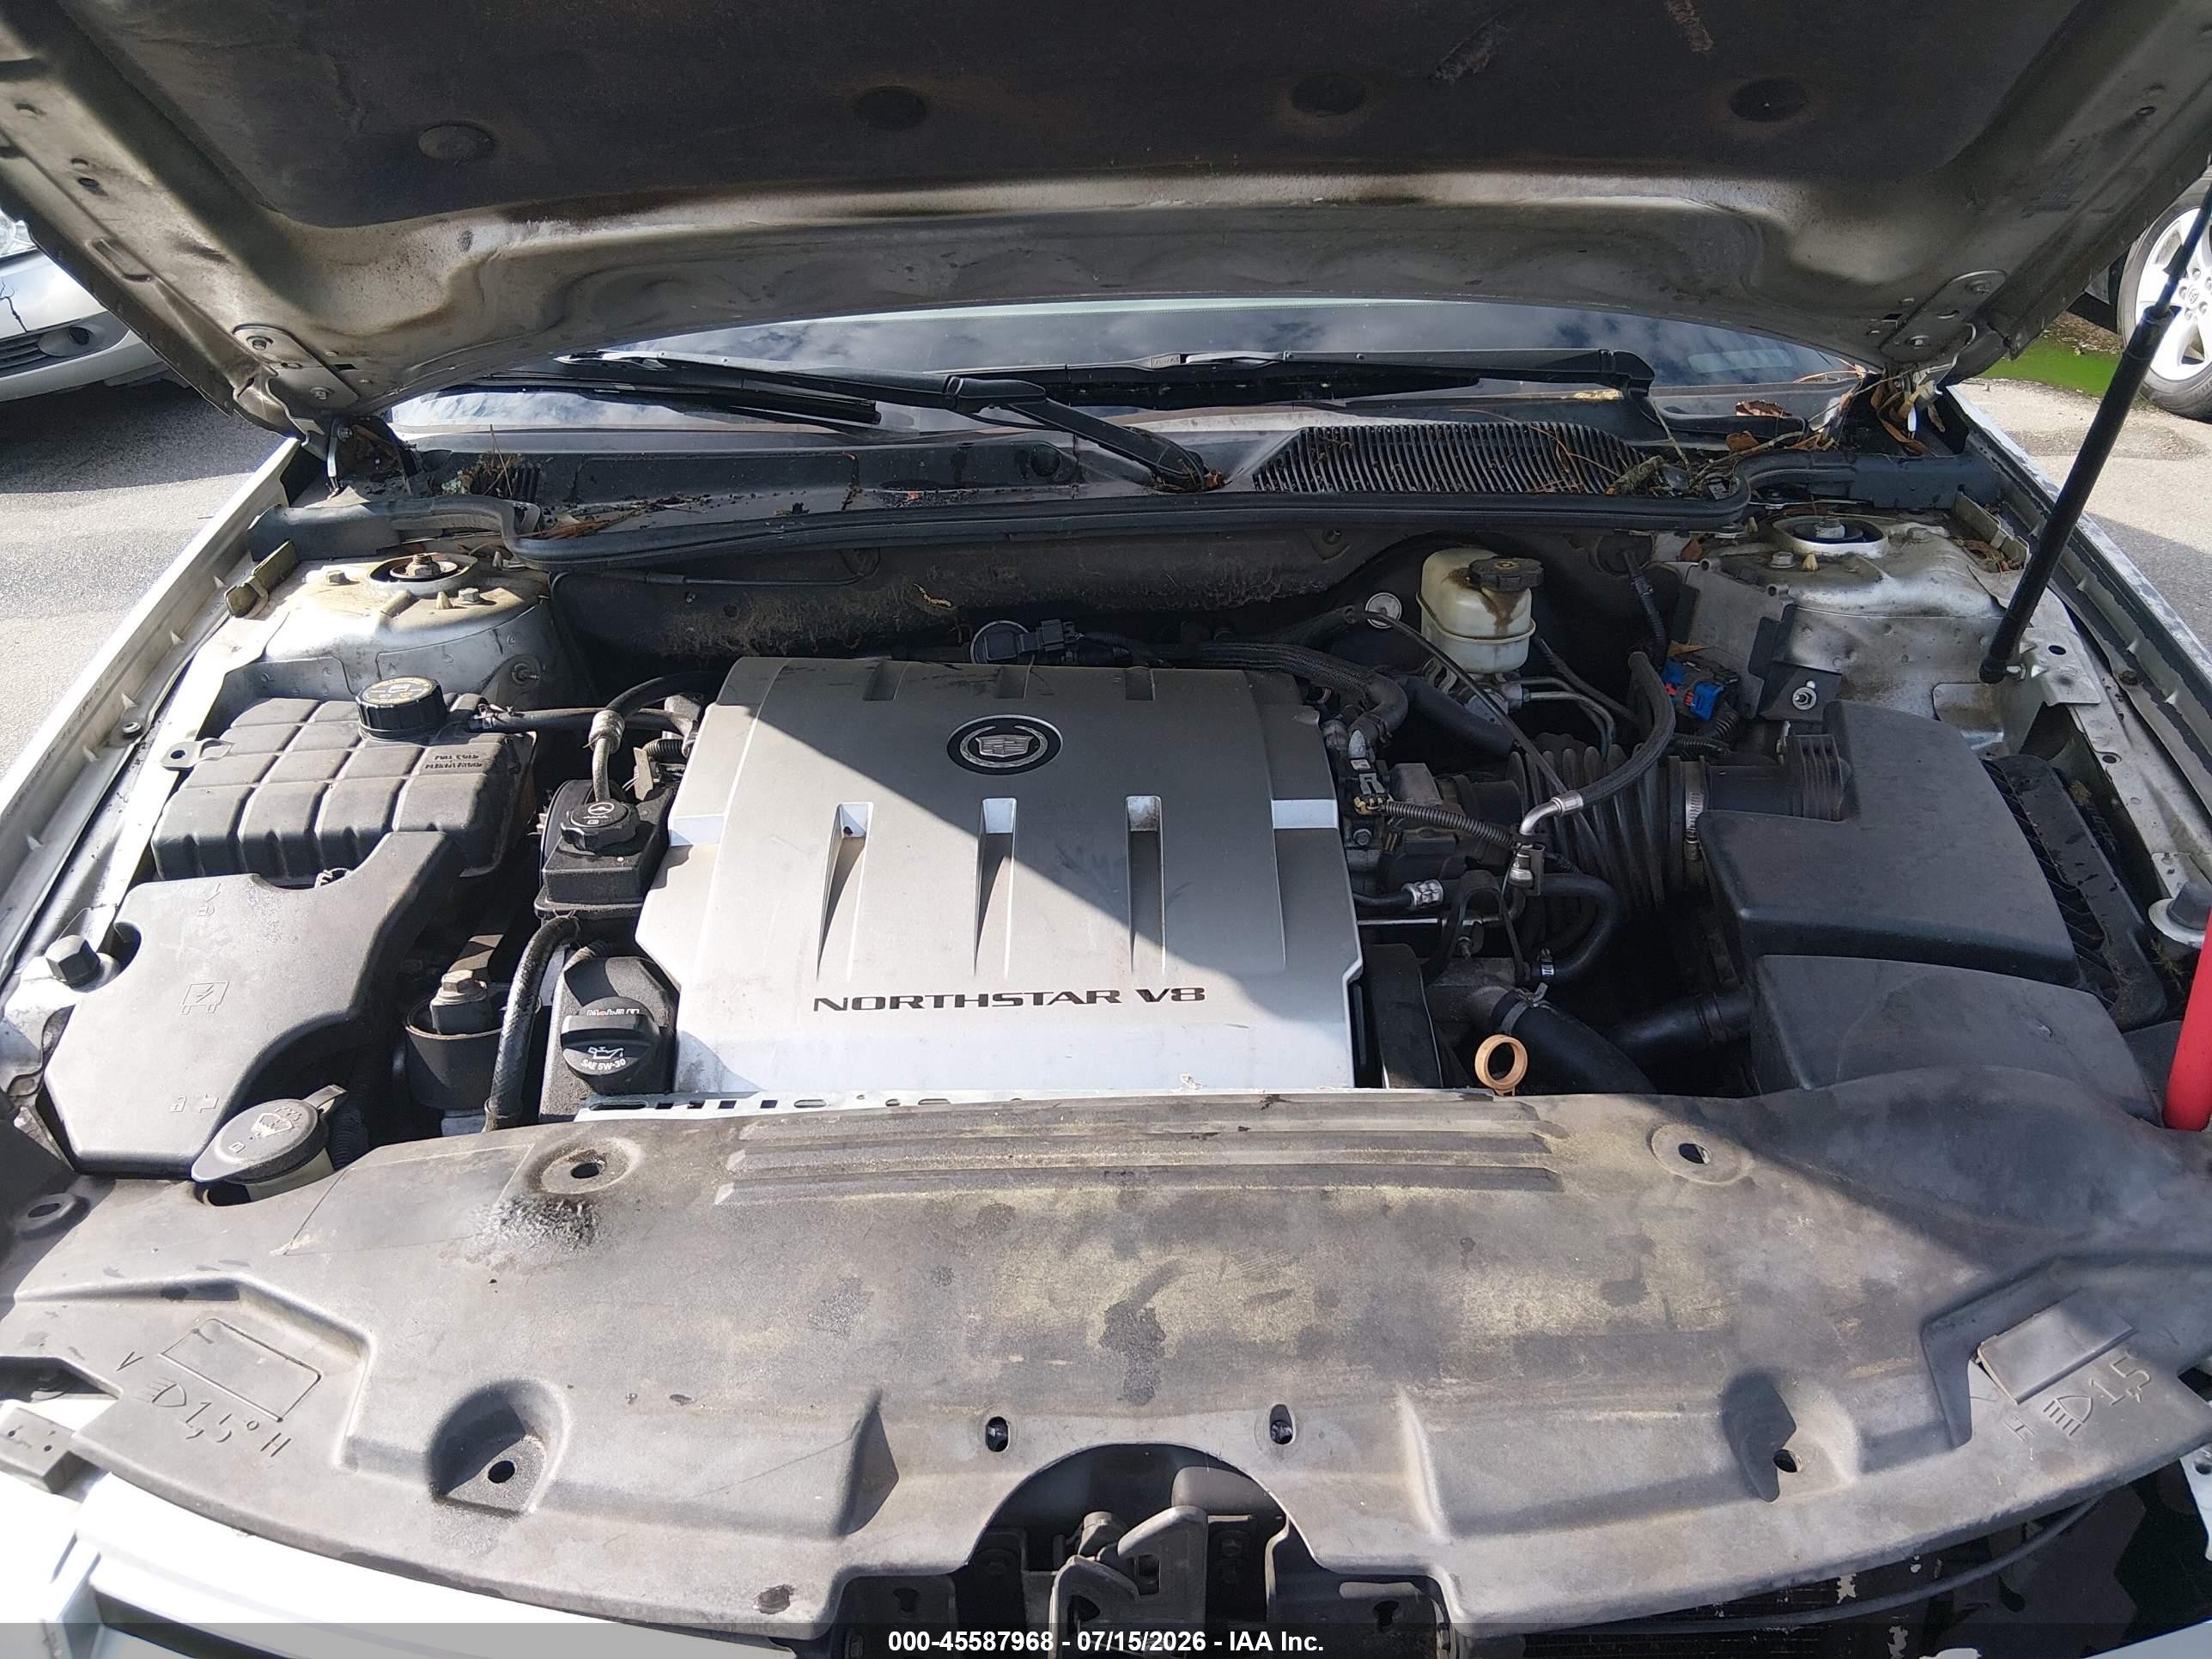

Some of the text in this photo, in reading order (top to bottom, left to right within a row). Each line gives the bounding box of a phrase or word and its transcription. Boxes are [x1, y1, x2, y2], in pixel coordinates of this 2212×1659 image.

[813, 988, 1206, 1012] NORTHSTAR V8
[580, 1058, 626, 1070] SAE 5W-30
[260, 1432, 292, 1457] H
